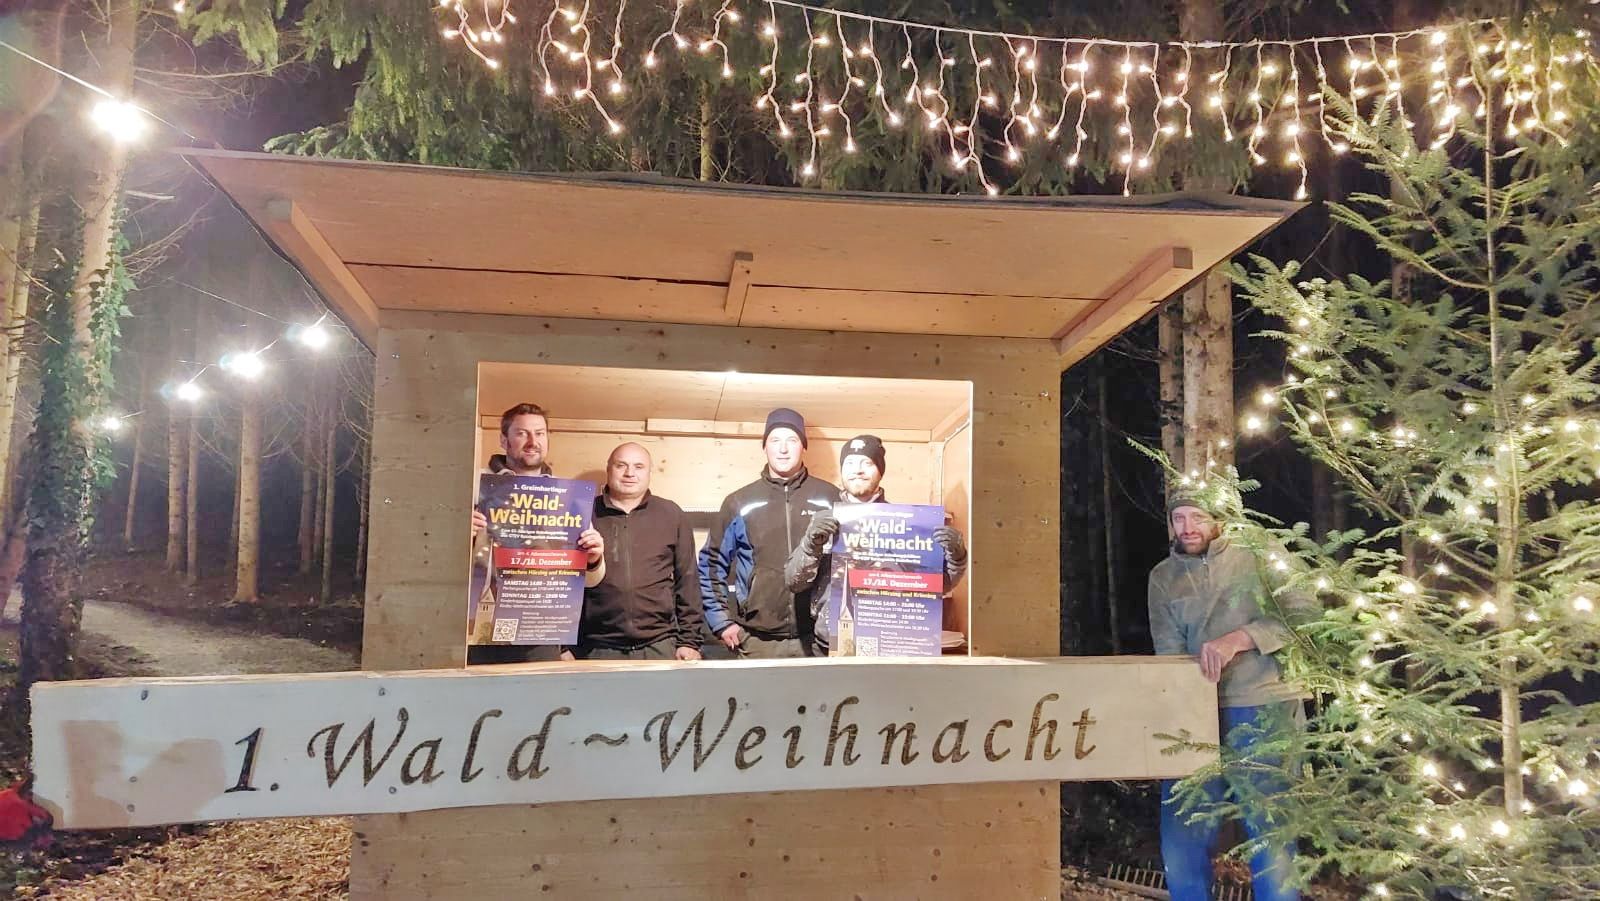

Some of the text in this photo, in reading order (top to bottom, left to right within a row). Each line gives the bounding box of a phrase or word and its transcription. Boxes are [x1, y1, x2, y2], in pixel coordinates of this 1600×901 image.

[512, 493, 564, 510] Wald-
[489, 508, 582, 528] Weihnacht
[859, 519, 912, 534] Wald-
[842, 532, 933, 551] Weihnacht
[538, 558, 572, 566] Dezember
[890, 579, 928, 588] Dezember
[225, 727, 279, 793] 1.
[307, 706, 571, 788] Wald
[643, 693, 1097, 774] Weihnacht
